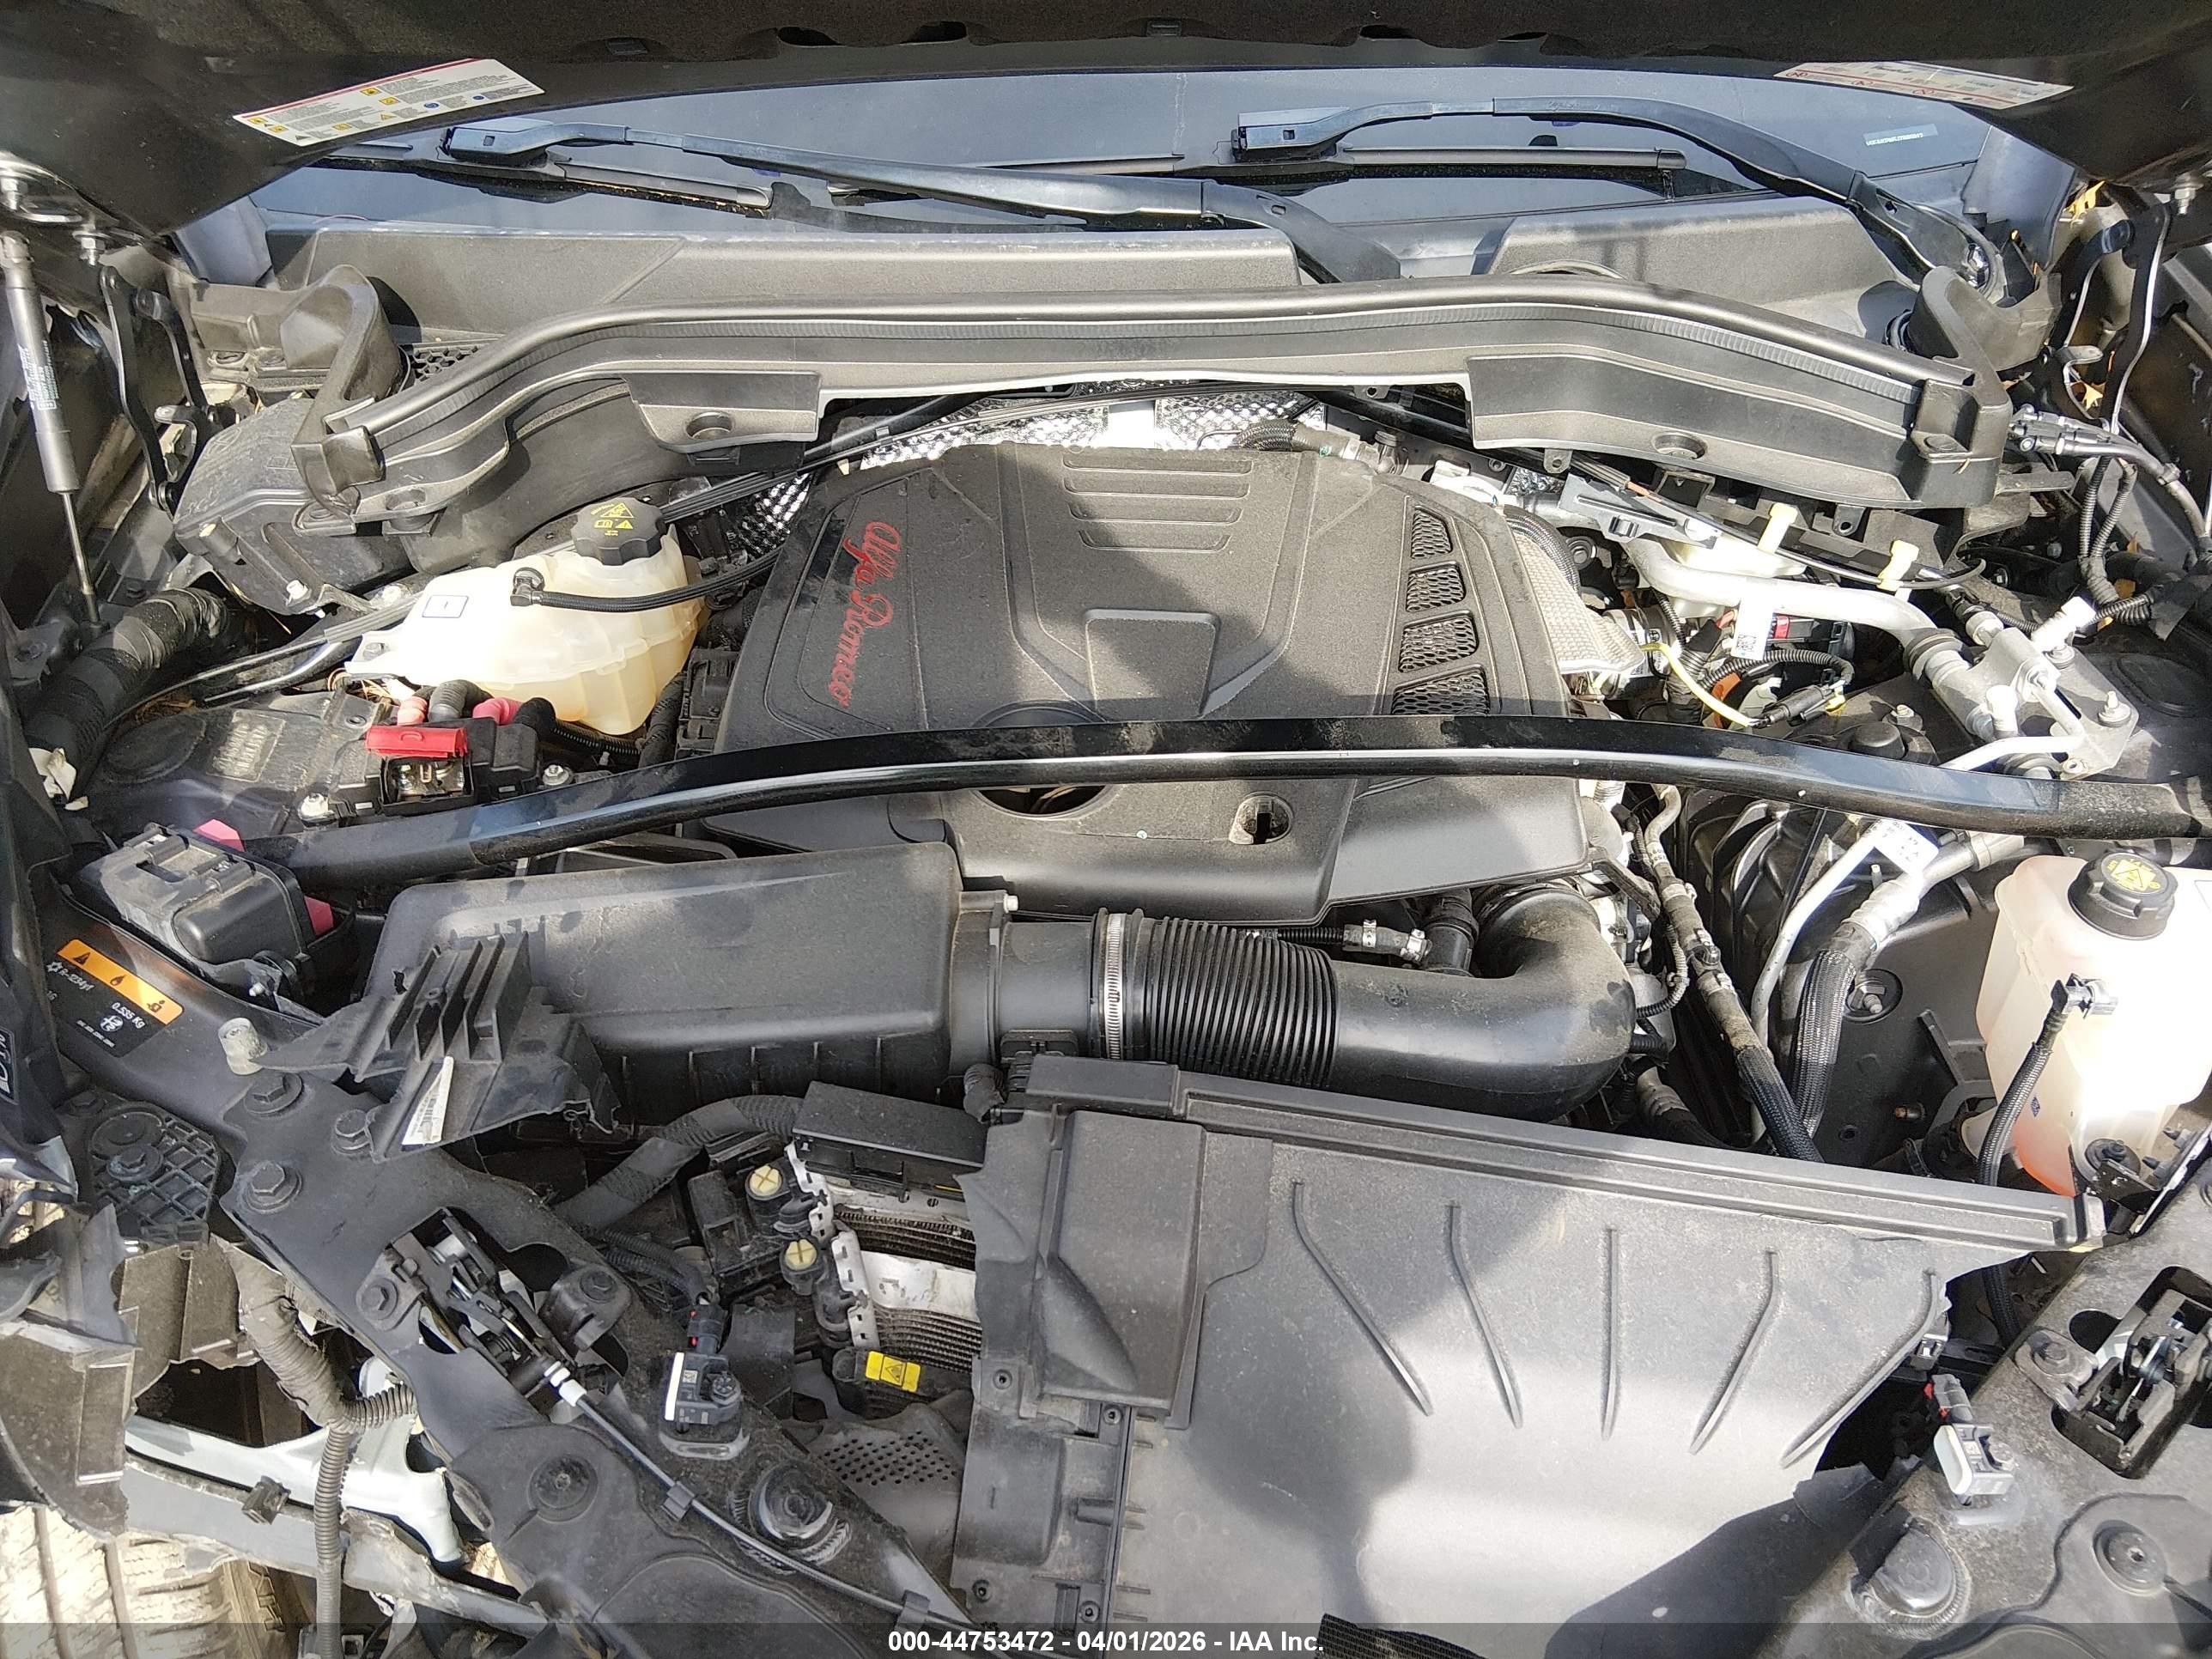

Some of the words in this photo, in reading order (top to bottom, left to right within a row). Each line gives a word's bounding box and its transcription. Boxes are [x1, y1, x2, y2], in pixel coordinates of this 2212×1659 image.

[842, 521, 901, 591] Alfa
[829, 588, 894, 709] Romeo
[131, 1016, 146, 1029] Kg
